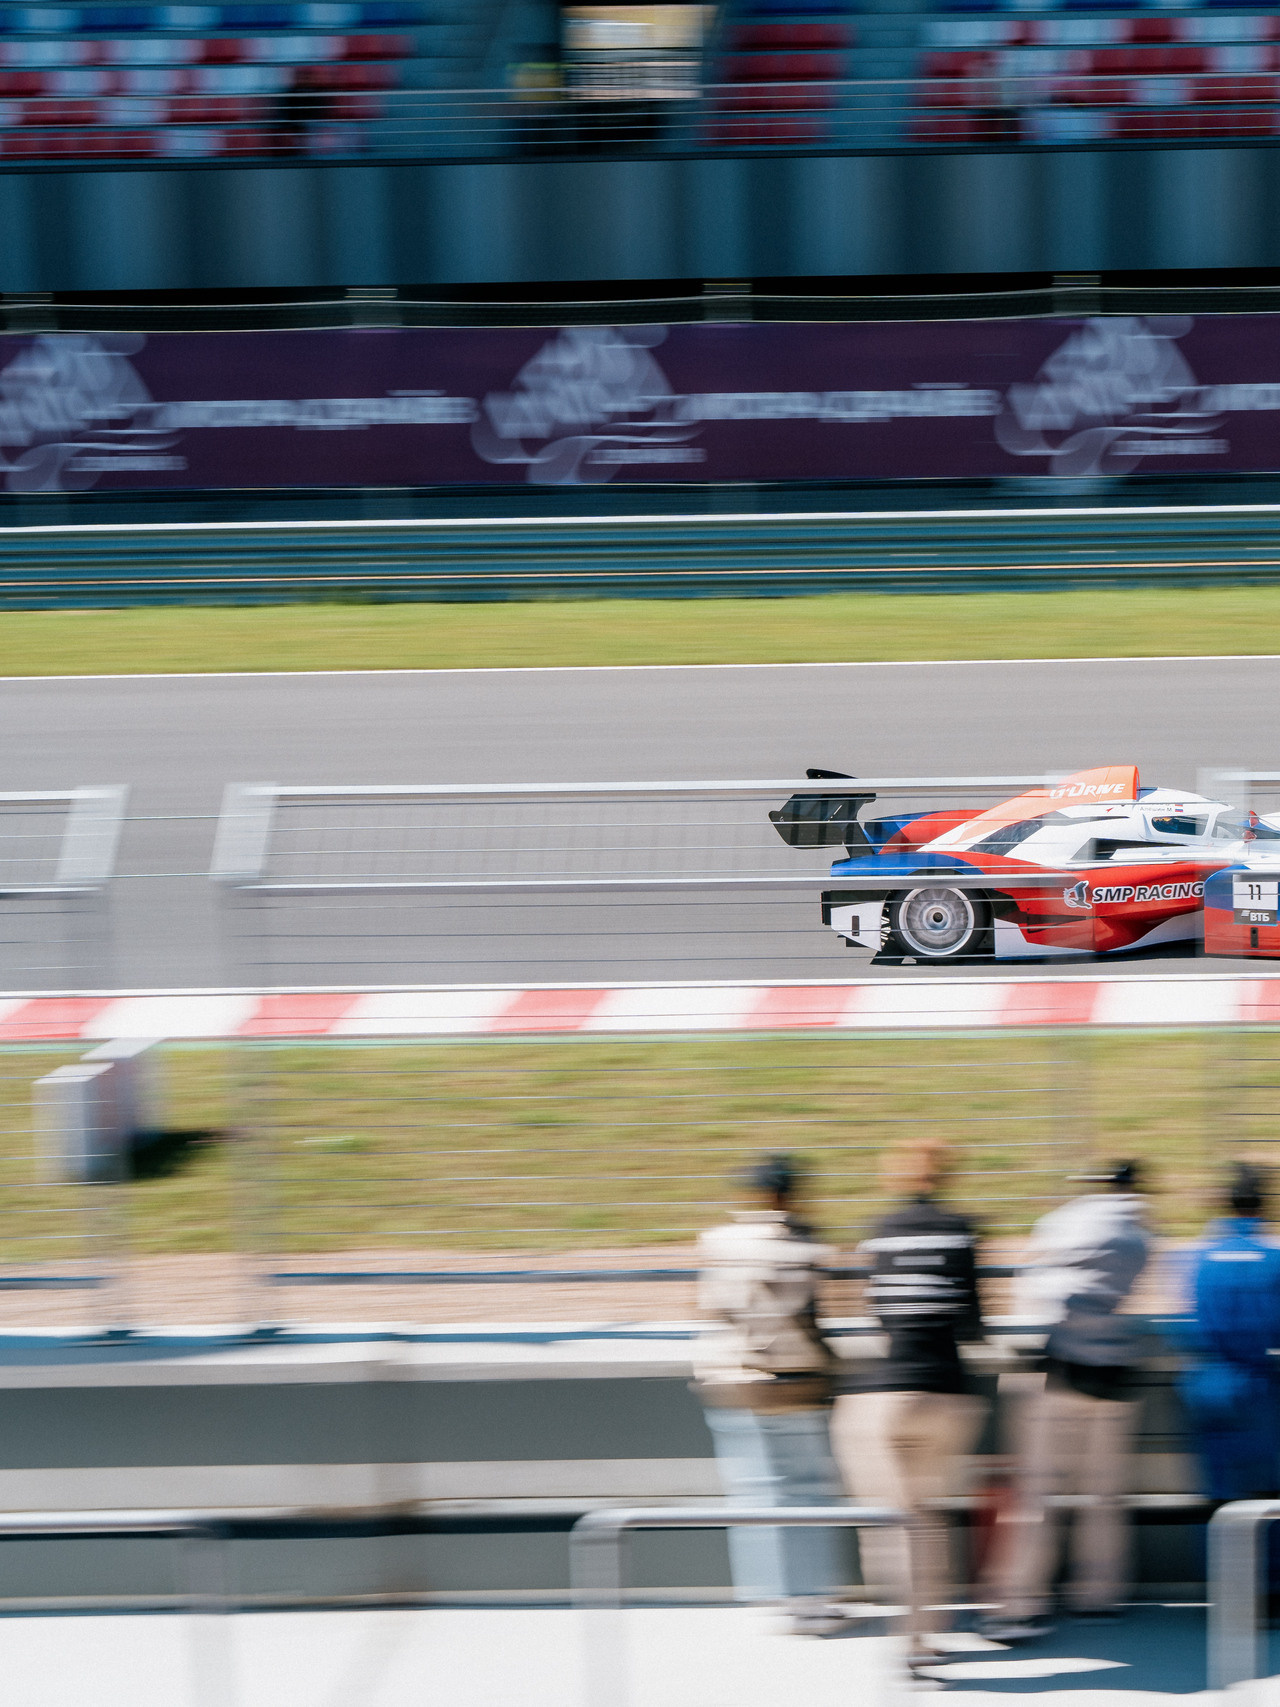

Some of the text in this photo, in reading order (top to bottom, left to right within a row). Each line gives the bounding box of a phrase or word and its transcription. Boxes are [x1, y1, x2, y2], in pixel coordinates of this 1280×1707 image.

[1092, 881, 1205, 903] SMP RACING
[1248, 884, 1261, 900] 11
[1249, 912, 1270, 922] ВТБ
